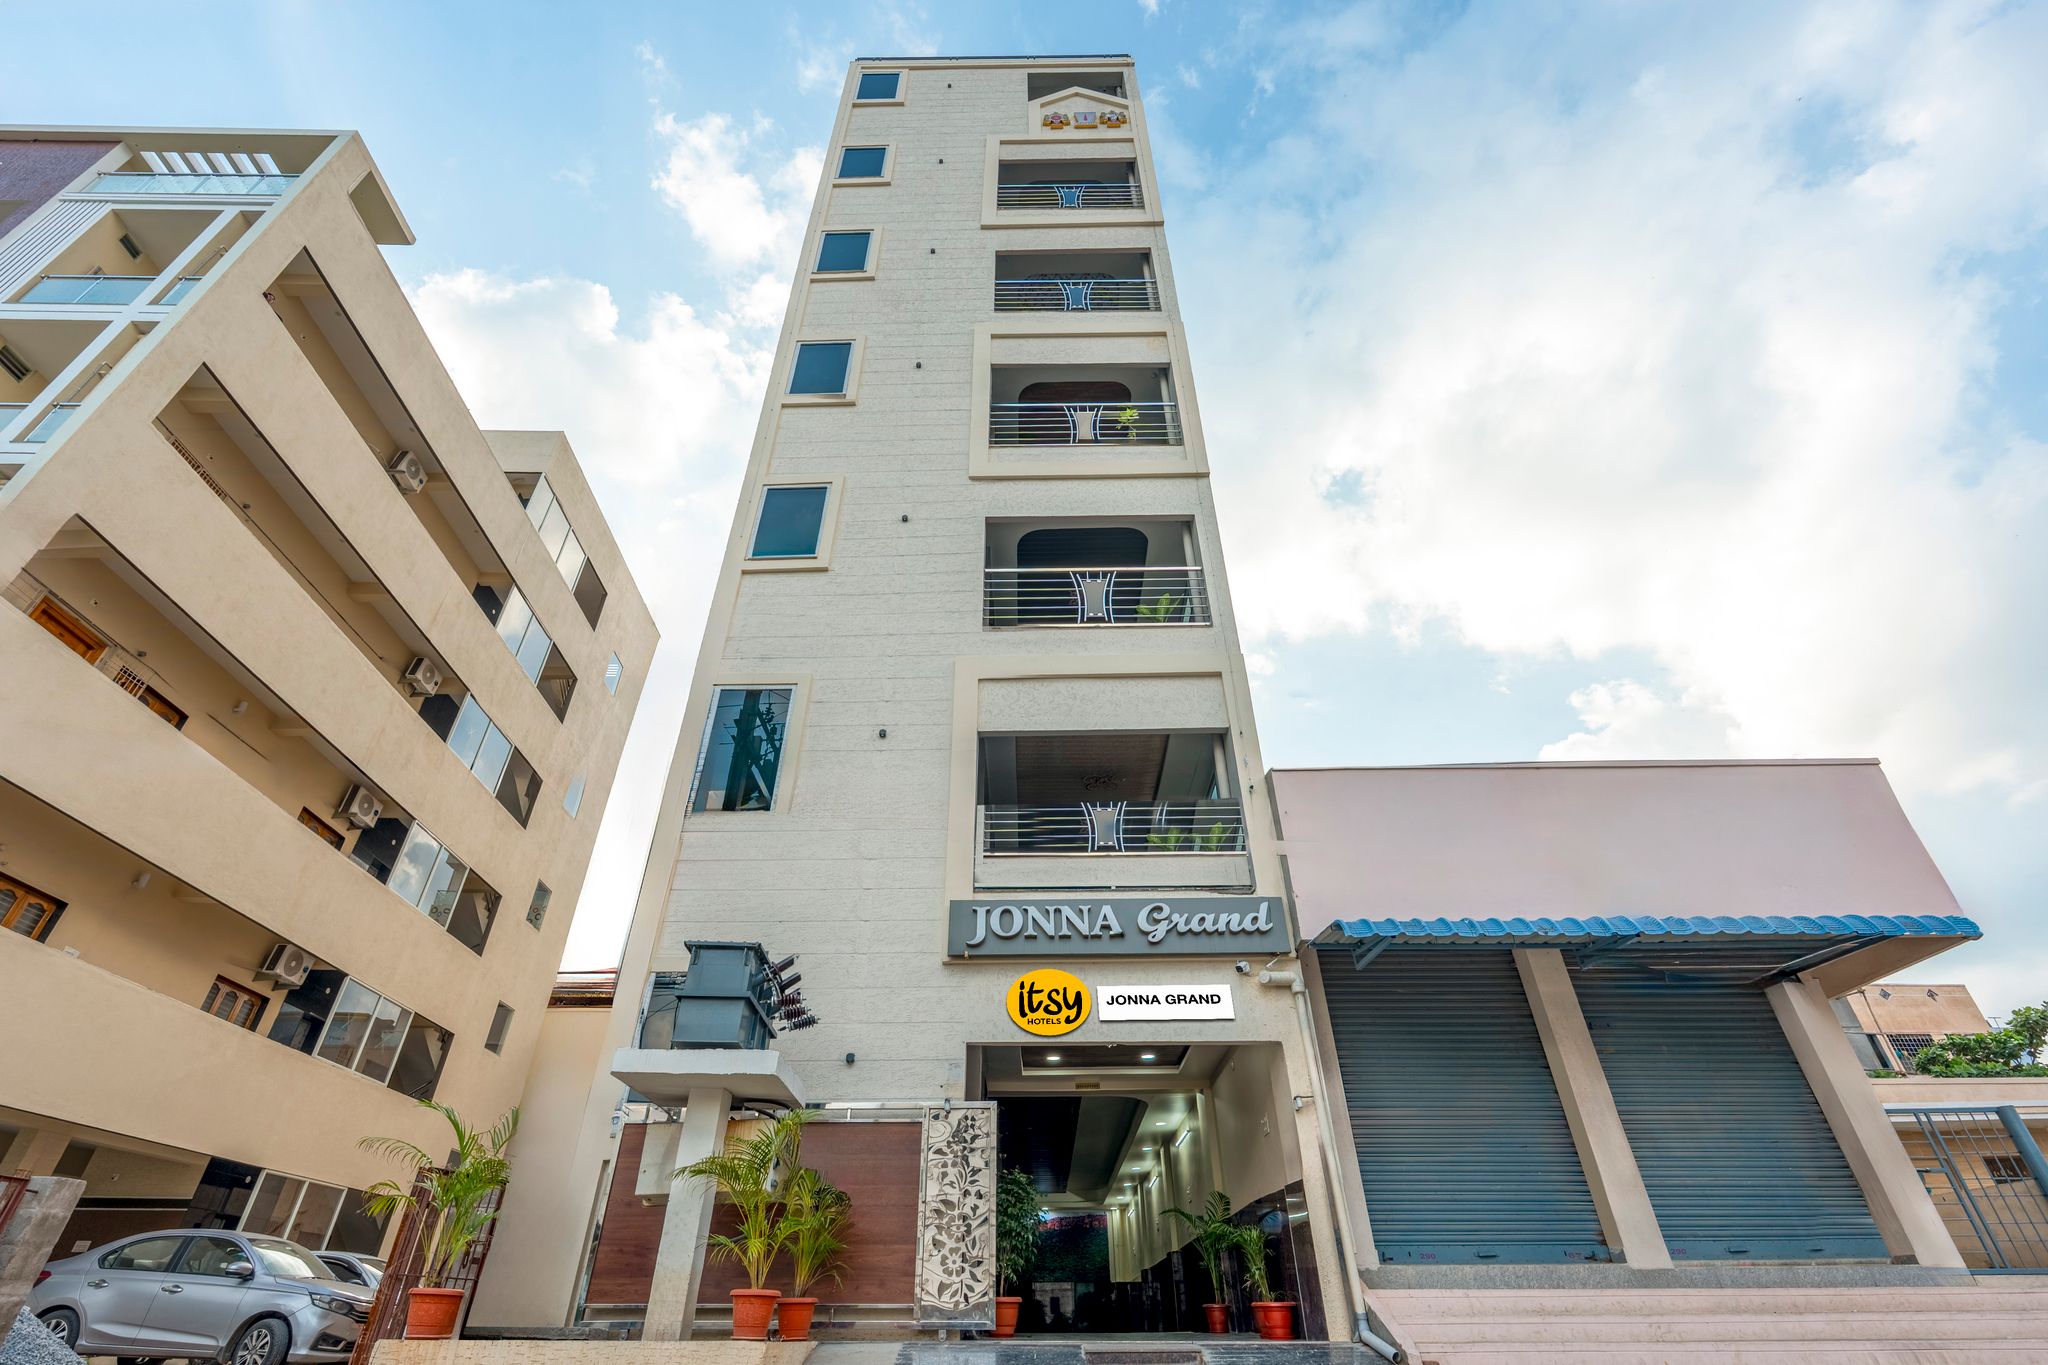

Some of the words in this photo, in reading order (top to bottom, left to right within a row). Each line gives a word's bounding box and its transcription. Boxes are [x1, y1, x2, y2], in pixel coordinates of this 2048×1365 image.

[966, 904, 1123, 946] JONNA
[1137, 901, 1273, 943] Grand
[1019, 981, 1083, 1025] itsy
[1106, 995, 1161, 1005] JONNA
[1165, 994, 1221, 1005] GRAND
